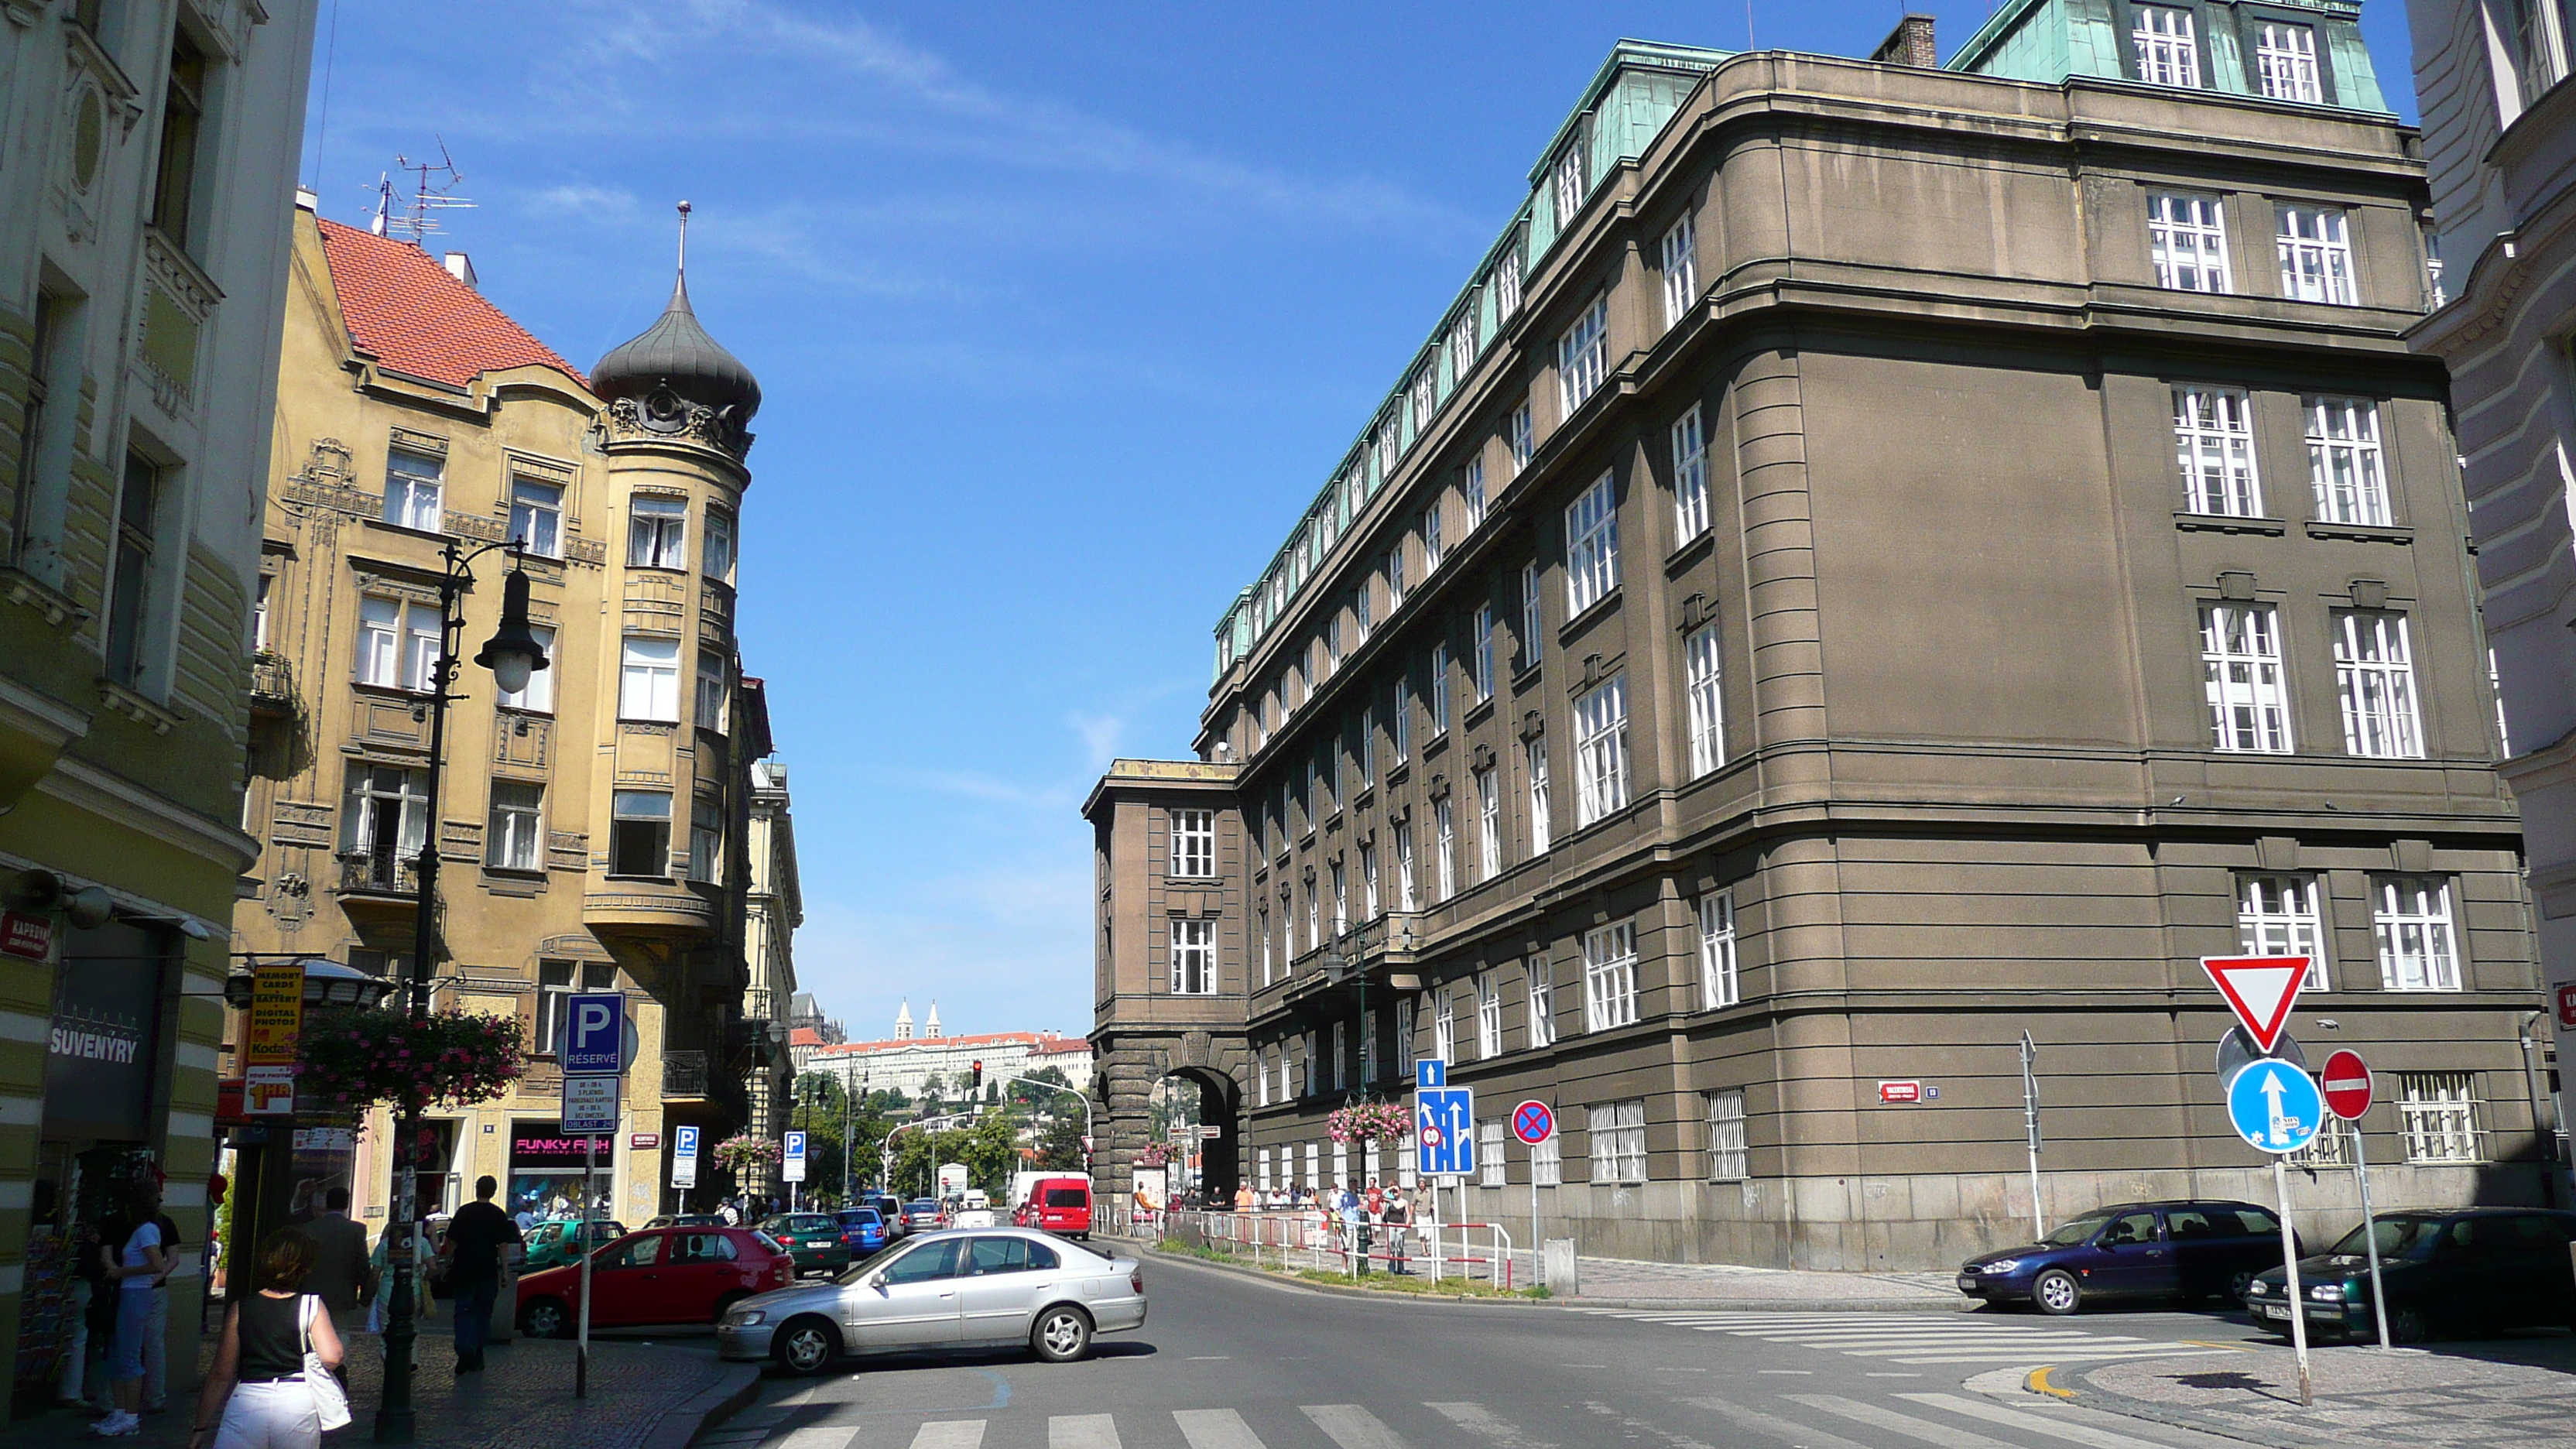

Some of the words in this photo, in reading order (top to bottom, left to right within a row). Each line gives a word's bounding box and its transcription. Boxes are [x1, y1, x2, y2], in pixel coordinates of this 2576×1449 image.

[577, 1004, 611, 1048] P
[50, 1028, 138, 1064] SUVENÝRY
[568, 1052, 617, 1064] RÉSERVÉ
[516, 1139, 570, 1149] FUNKY
[680, 1130, 694, 1148] P
[789, 1135, 801, 1152] P
